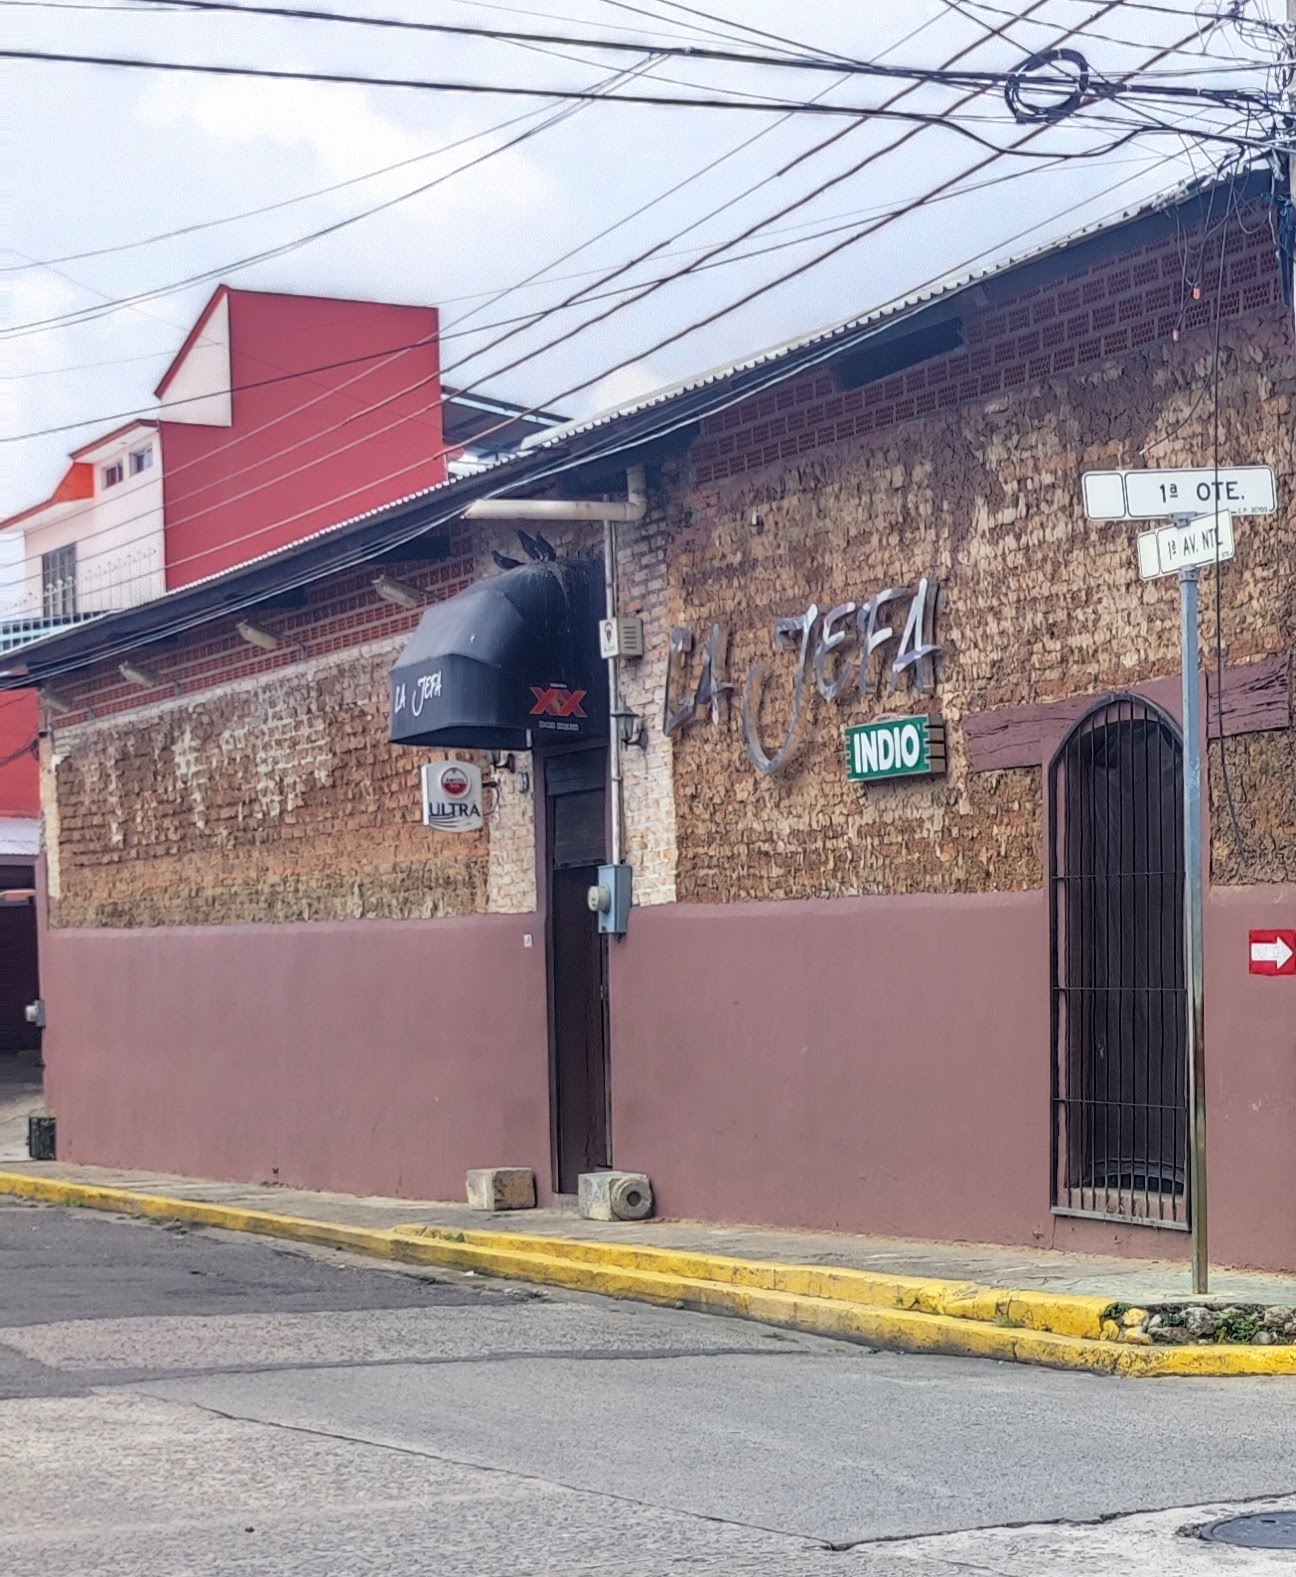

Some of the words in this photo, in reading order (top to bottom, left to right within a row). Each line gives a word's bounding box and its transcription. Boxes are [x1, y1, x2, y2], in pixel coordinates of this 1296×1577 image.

[1196, 481, 1245, 501] OTE.
[1183, 533, 1199, 556] AV.
[662, 623, 734, 738] LA
[742, 577, 942, 775] JEFA
[394, 682, 406, 714] LA
[411, 669, 442, 717] JEFA
[528, 686, 588, 718] XX
[853, 723, 920, 774] INDIO
[428, 802, 481, 818] ULTRA
